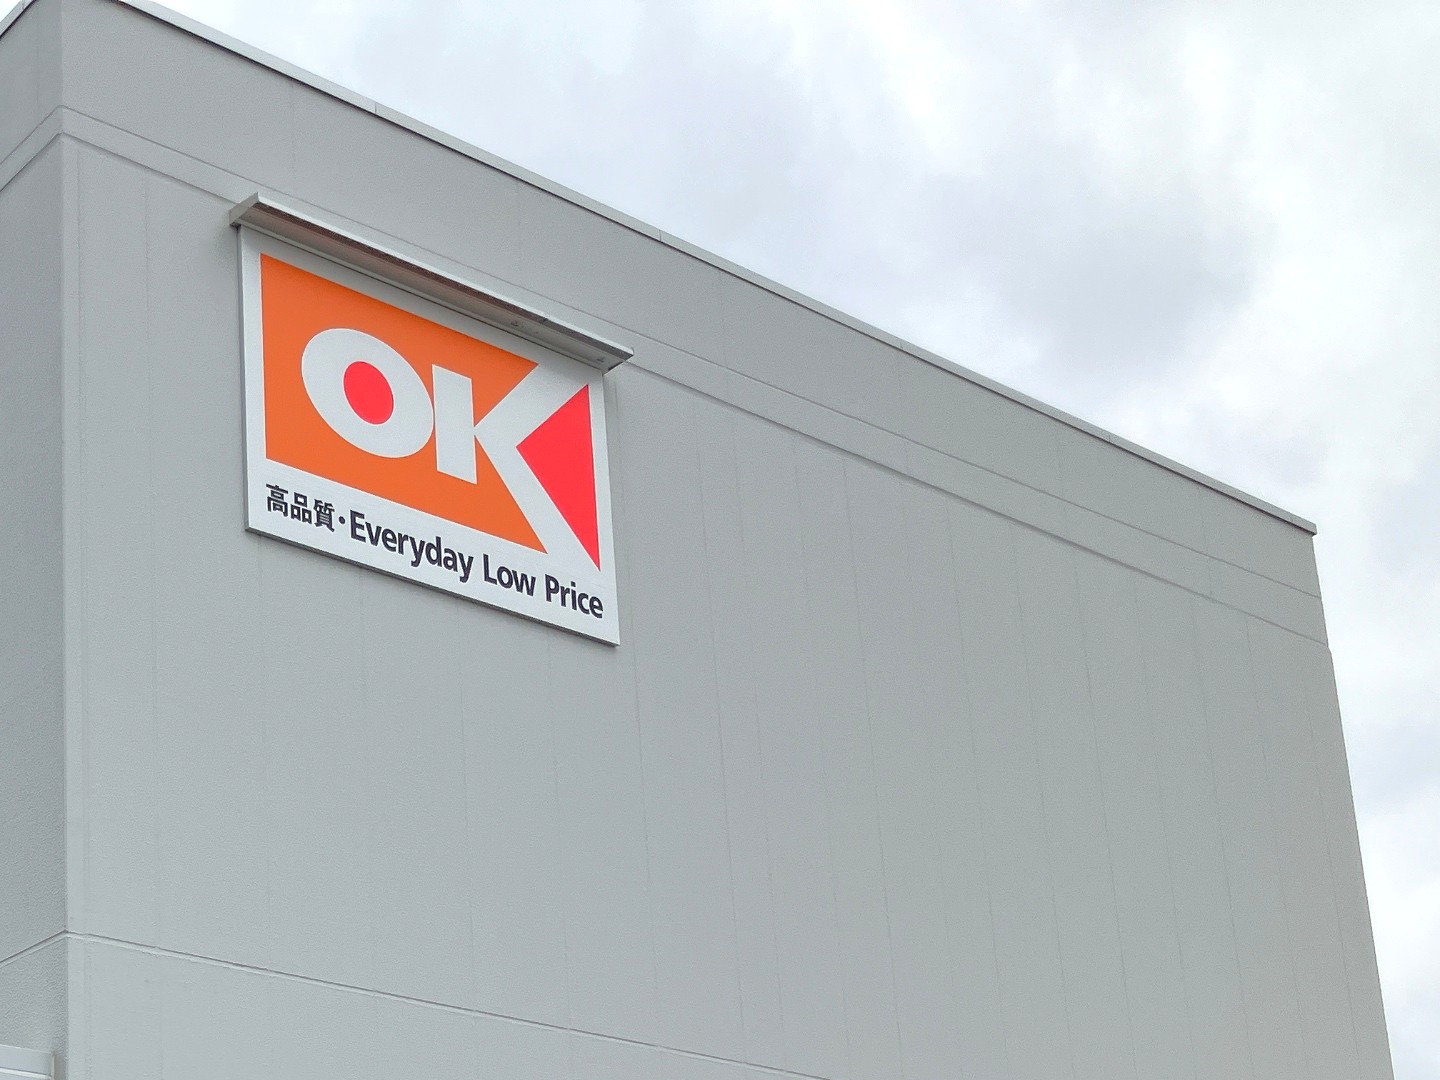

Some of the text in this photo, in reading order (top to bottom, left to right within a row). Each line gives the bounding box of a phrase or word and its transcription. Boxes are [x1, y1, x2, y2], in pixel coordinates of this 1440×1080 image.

[301, 328, 600, 571] OK
[484, 554, 536, 597] Low
[545, 574, 604, 619] Price
